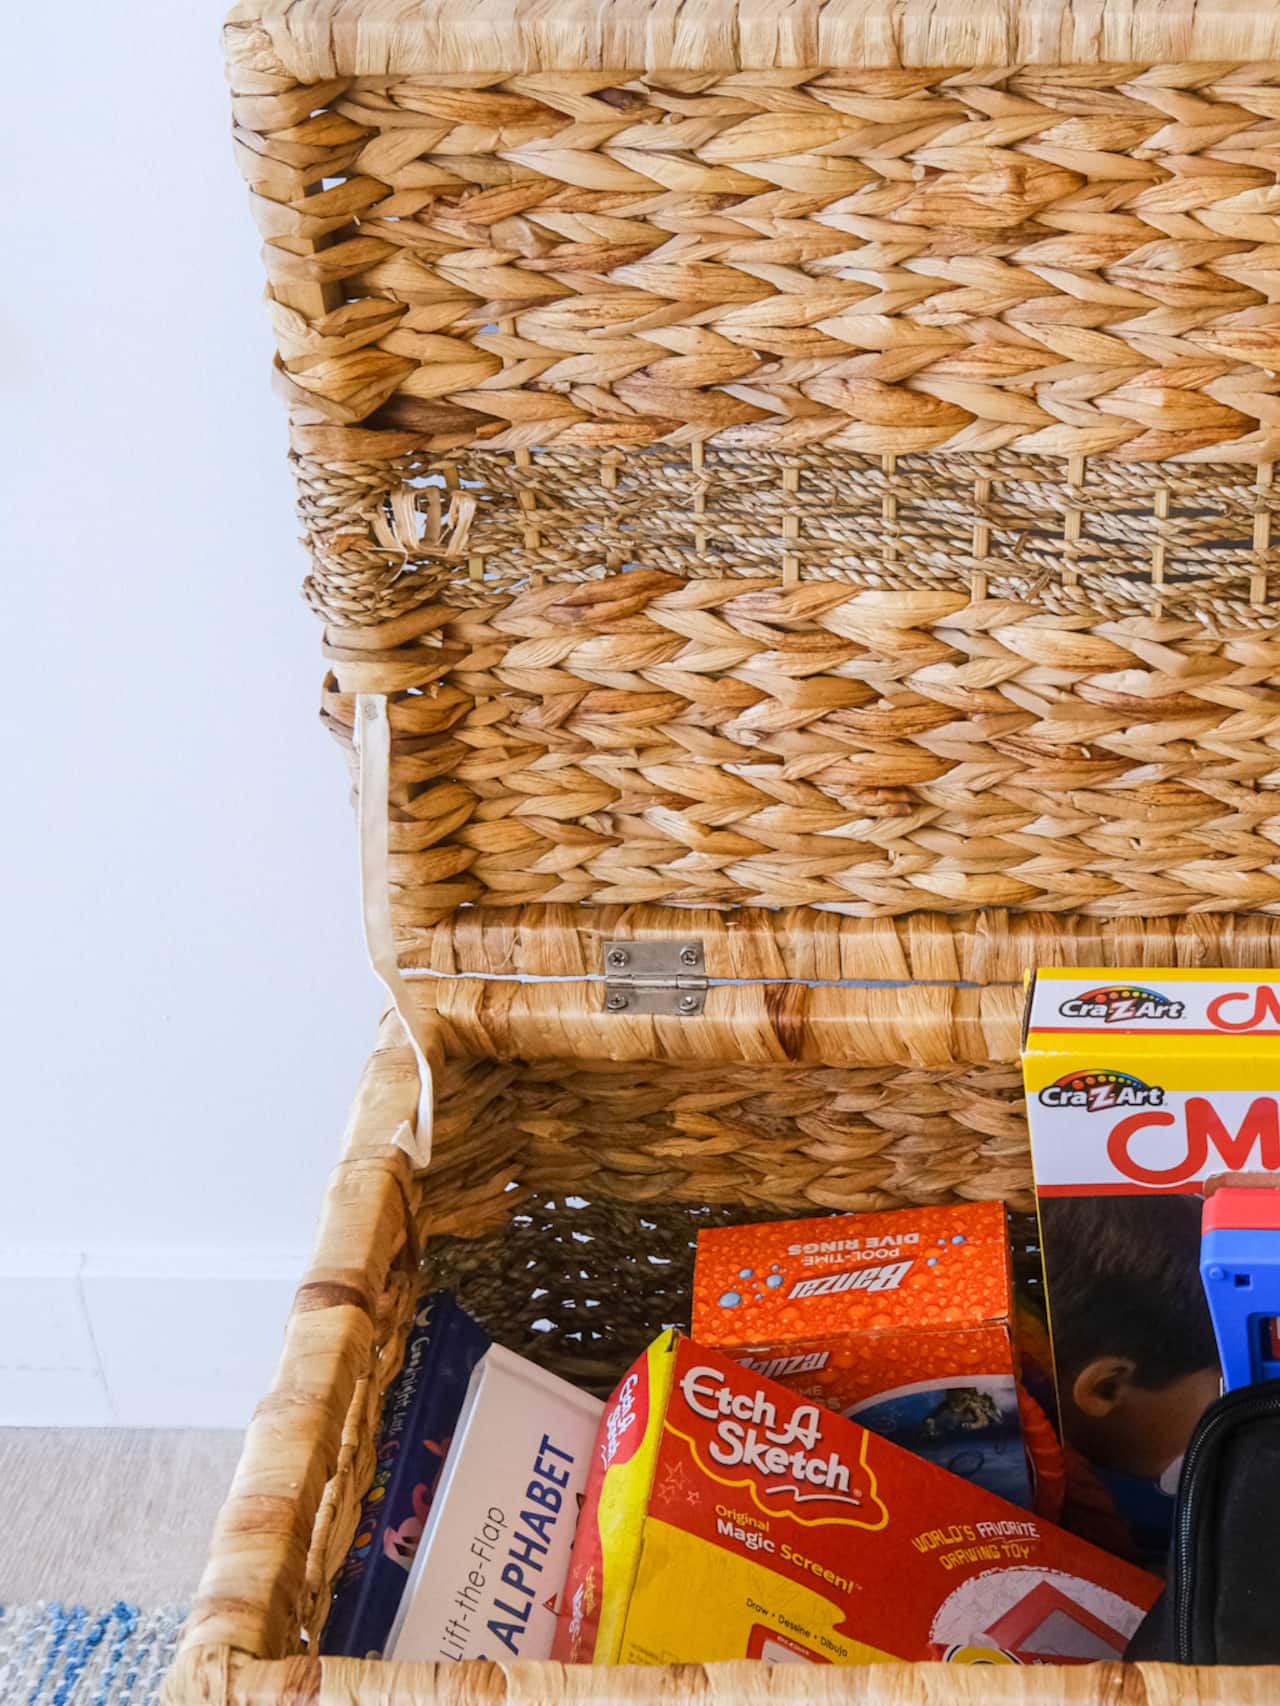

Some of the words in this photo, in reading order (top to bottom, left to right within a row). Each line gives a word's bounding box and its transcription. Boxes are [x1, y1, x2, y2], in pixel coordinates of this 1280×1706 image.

[787, 1239, 860, 1256] RINGS
[802, 1247, 900, 1267] POOL-TIME
[864, 1232, 920, 1249] DIVE
[787, 1259, 916, 1301] Banzai
[679, 1366, 777, 1429] Etch
[765, 1404, 823, 1451] A
[708, 1419, 851, 1492] Sketch
[714, 1503, 771, 1533] Original
[911, 1524, 978, 1554] WORLD'S
[485, 1433, 576, 1657] ALPHABET
[716, 1518, 777, 1554] Magic
[779, 1543, 856, 1595] Screen!
[939, 1543, 1001, 1571] DRAWING
[1001, 1542, 1031, 1560] TOY
[439, 1505, 510, 1663] Lift-the-Flap
[745, 1597, 769, 1617] Draw
[777, 1613, 812, 1640] Dessine
[819, 1635, 850, 1659] Dibuja
